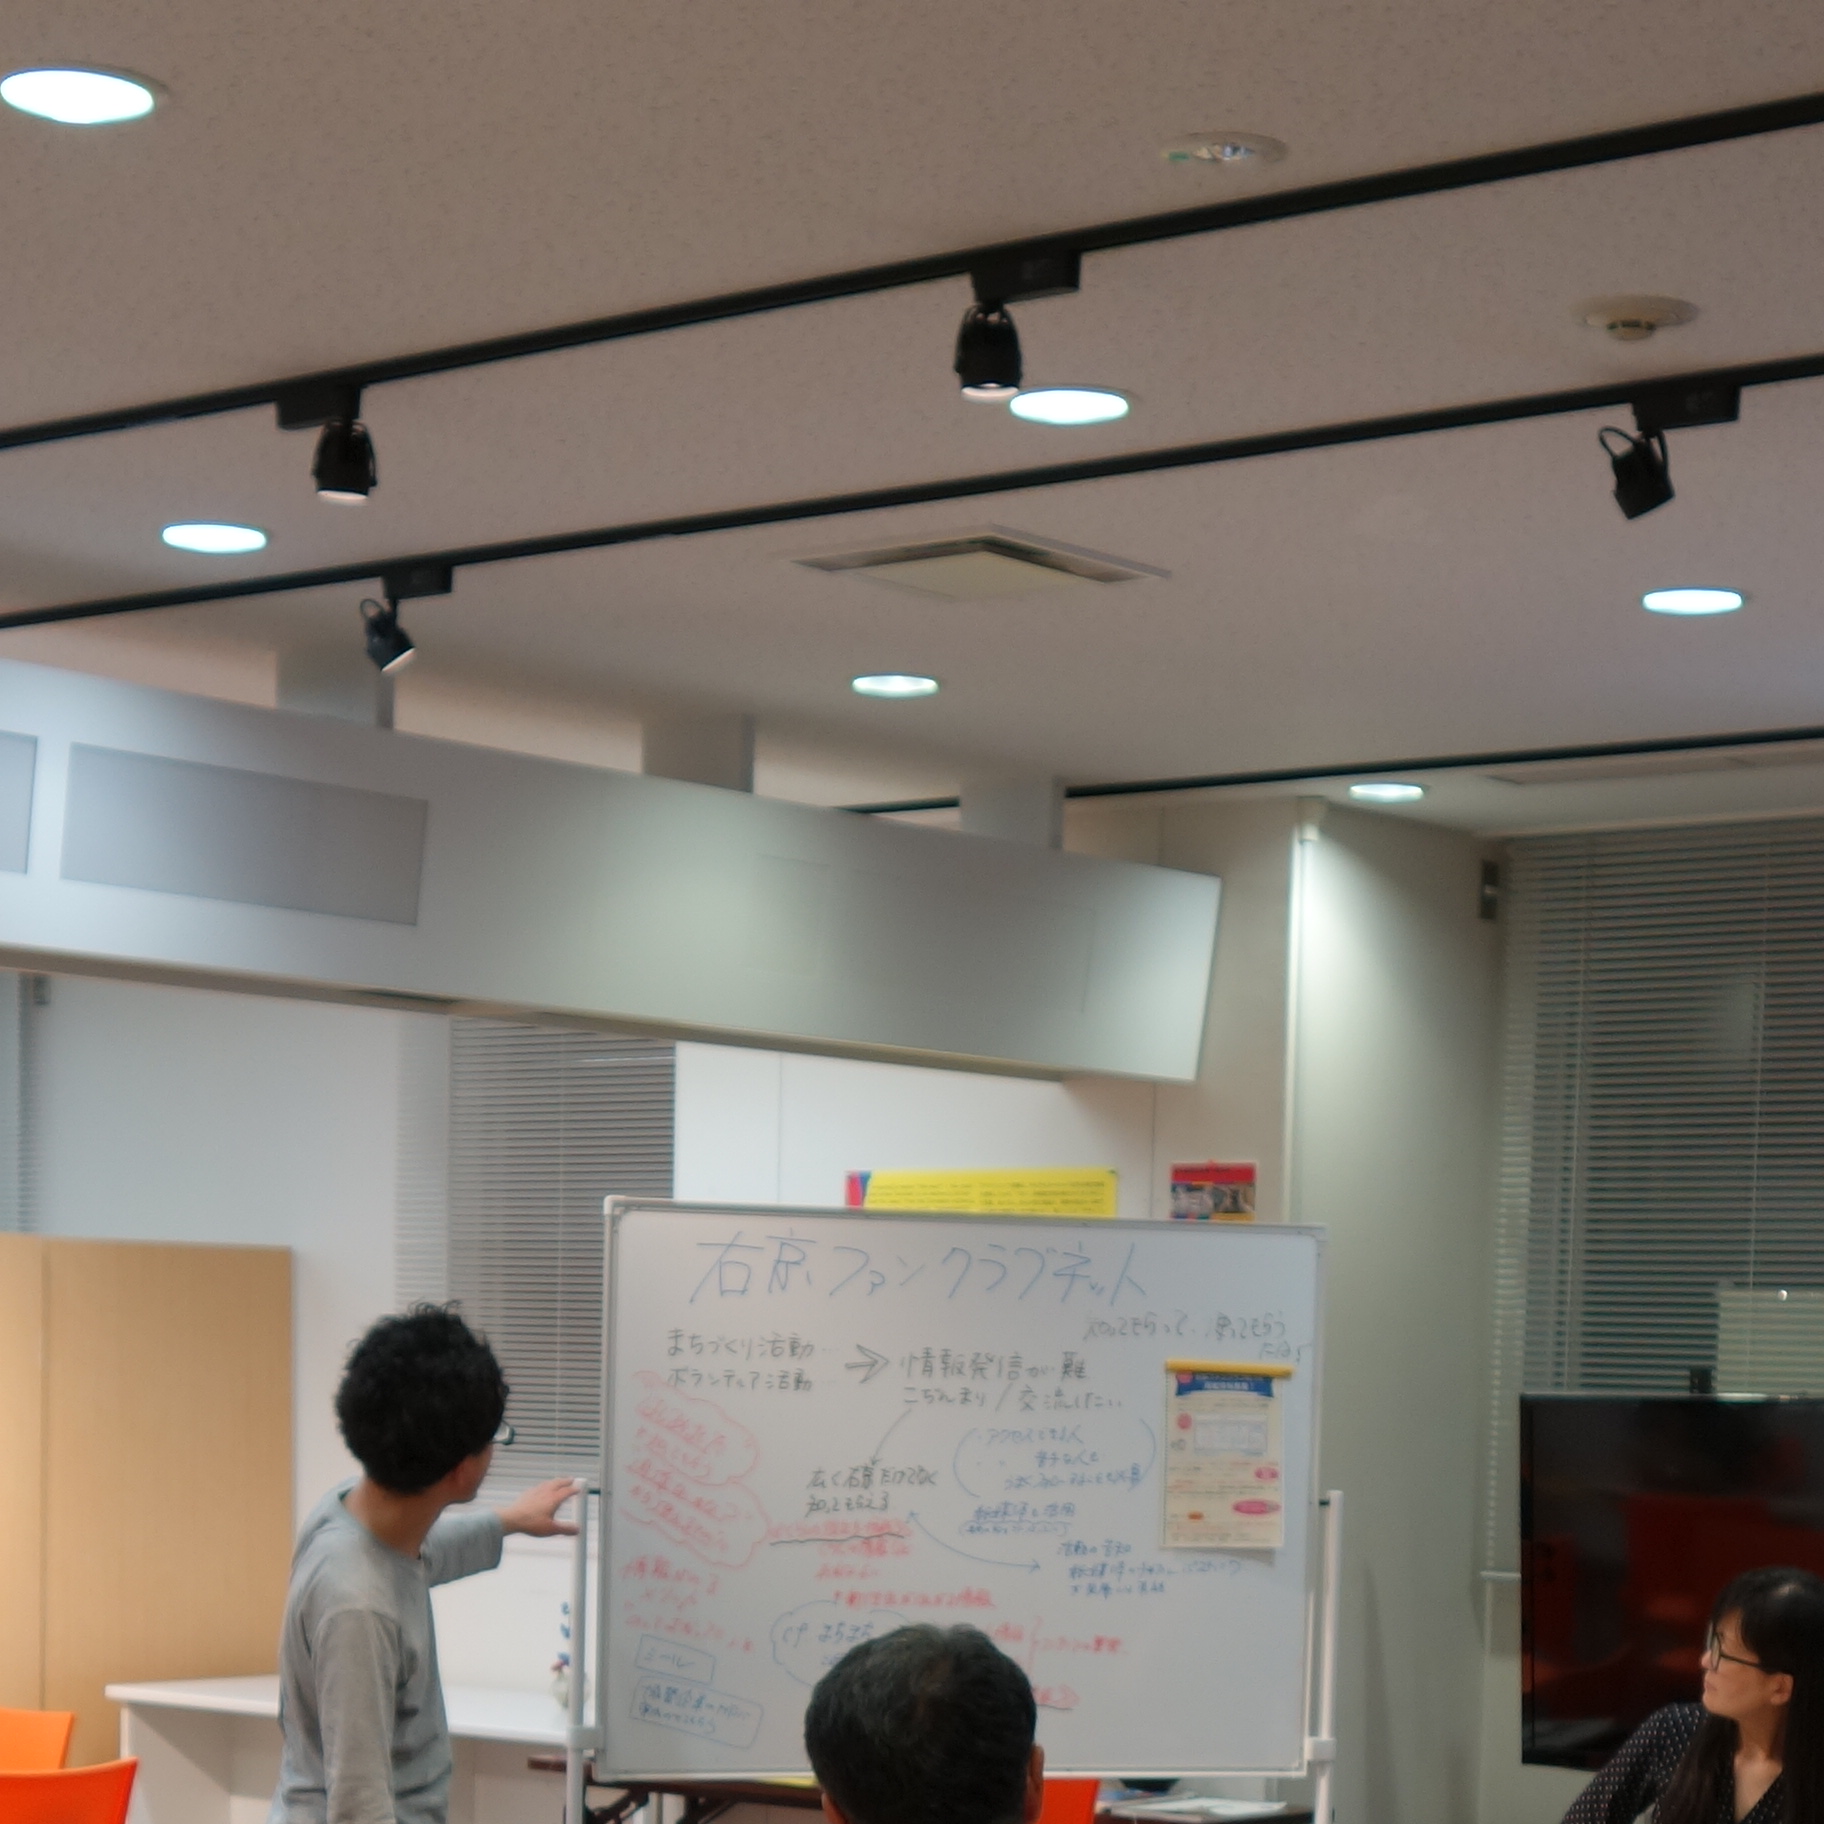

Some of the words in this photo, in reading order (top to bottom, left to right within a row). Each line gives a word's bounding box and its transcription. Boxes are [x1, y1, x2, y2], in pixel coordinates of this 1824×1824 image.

[690, 1227, 1147, 1305] 右京ファンクラブネット
